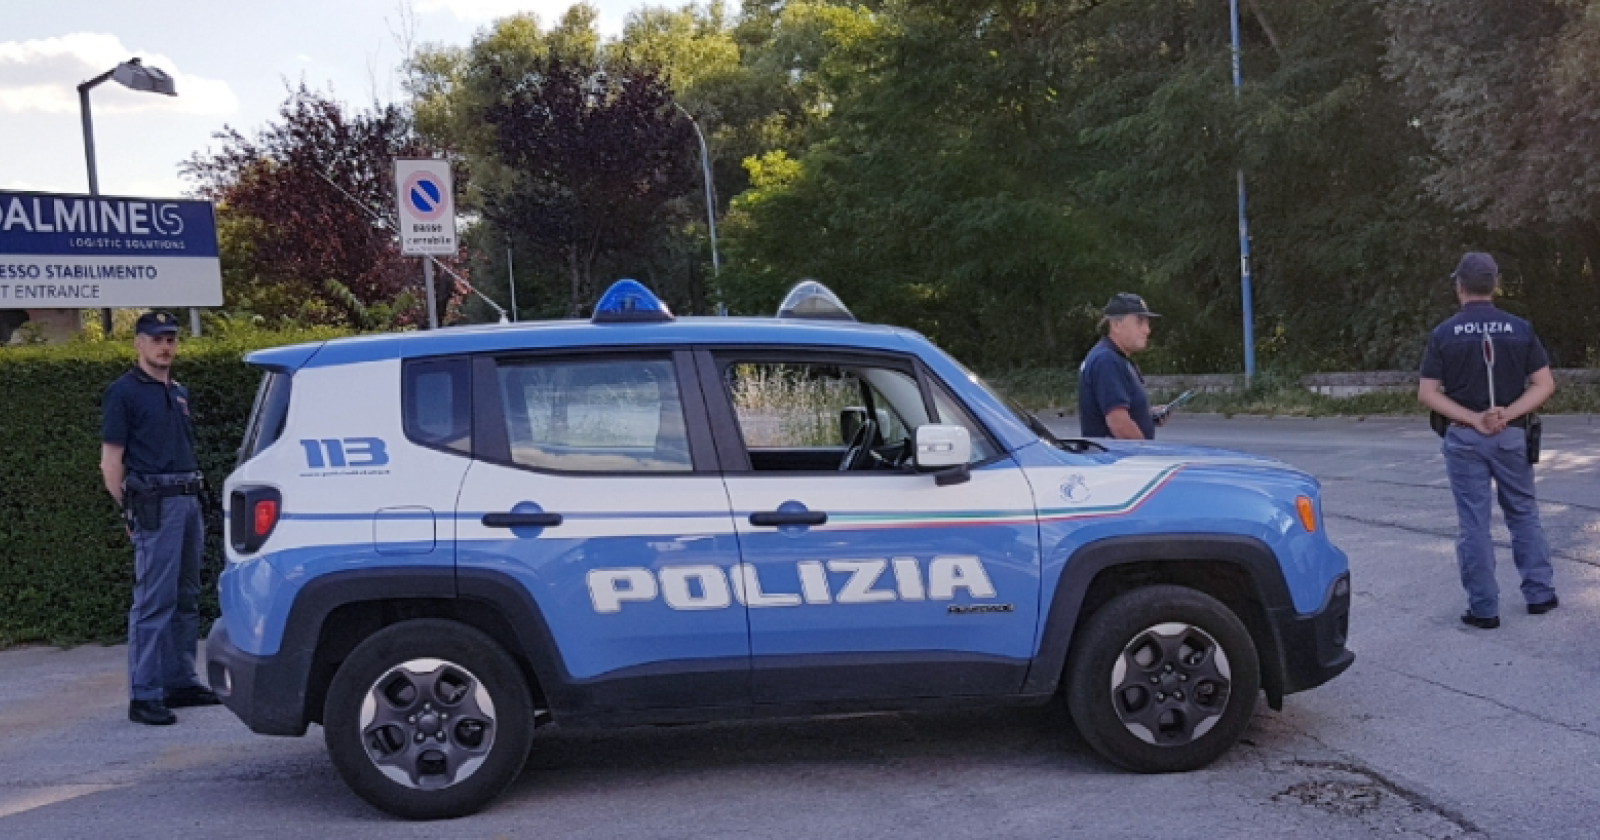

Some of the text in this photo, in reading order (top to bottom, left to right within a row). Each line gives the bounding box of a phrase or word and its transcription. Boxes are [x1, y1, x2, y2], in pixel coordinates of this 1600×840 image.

[0, 197, 150, 234] ALMINE
[70, 238, 186, 249] LOGISTIC SOLUTIONS
[45, 265, 157, 279] STABILIMENTO
[15, 285, 100, 299] ENTRANCE
[1454, 322, 1513, 335] POLIZIA
[300, 437, 390, 468] 113
[586, 555, 997, 614] POLIZIA
